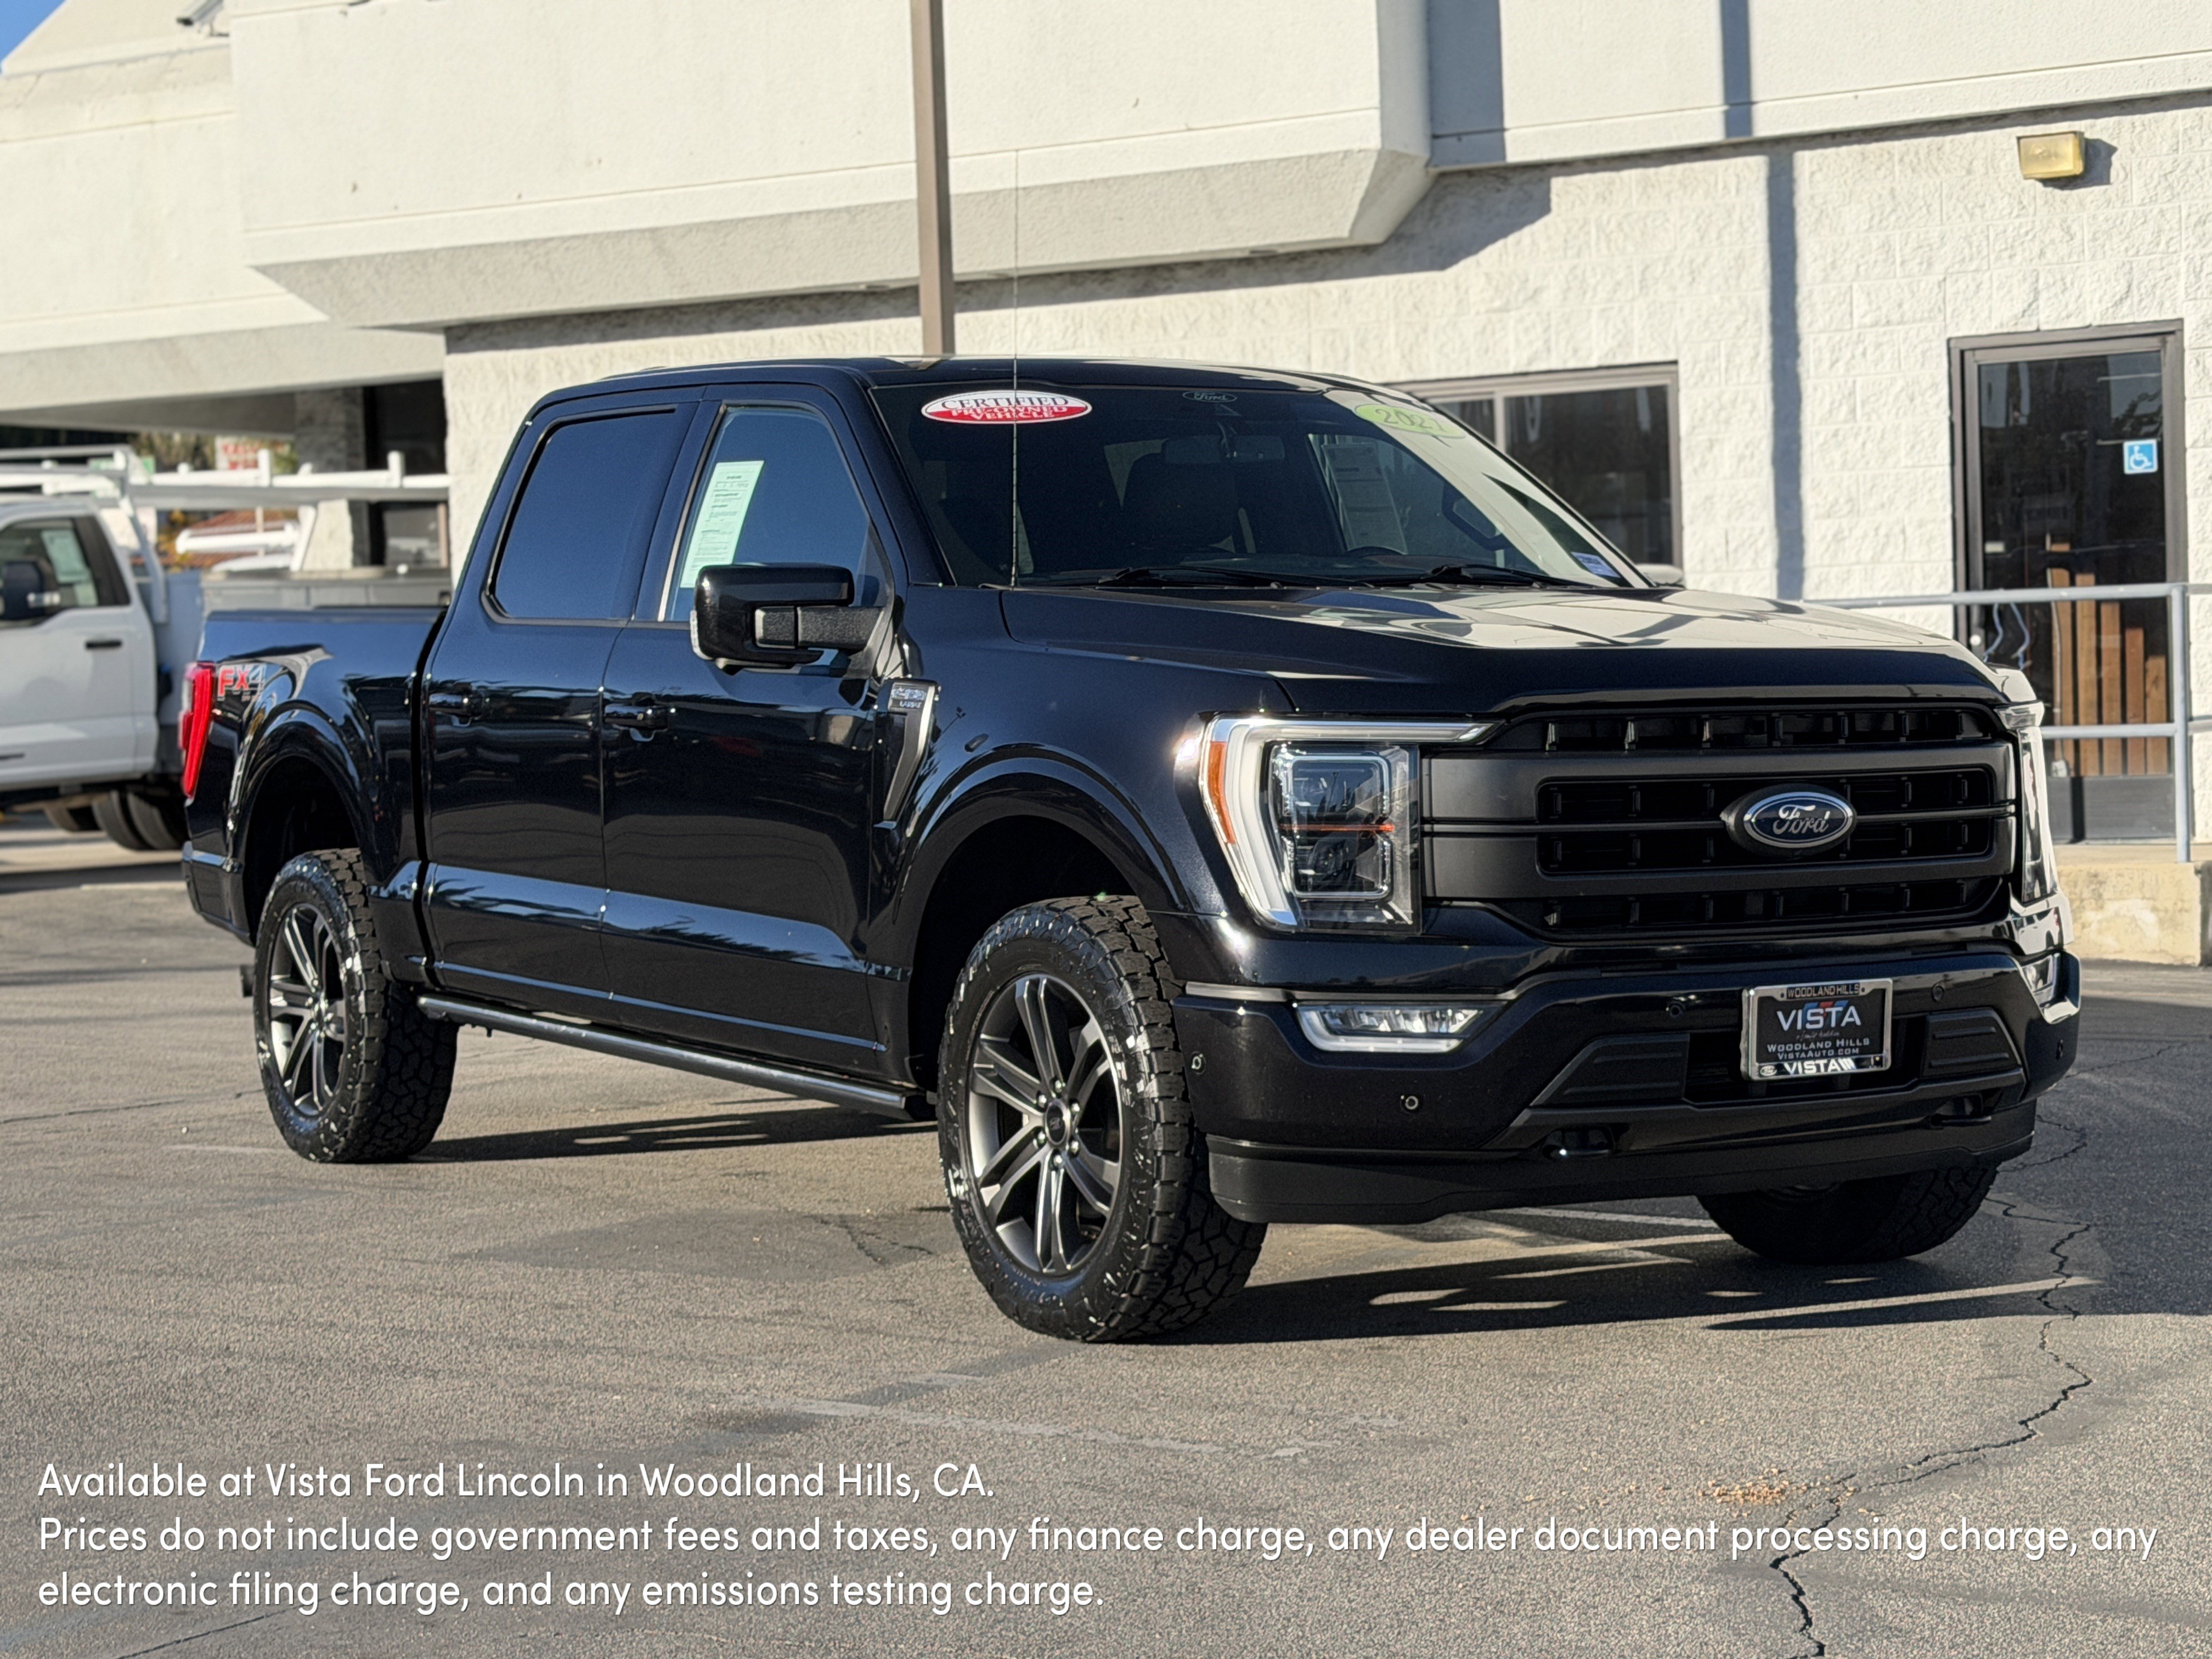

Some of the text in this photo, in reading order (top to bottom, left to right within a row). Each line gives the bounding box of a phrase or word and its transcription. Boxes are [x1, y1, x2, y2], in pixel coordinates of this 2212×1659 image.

[941, 397, 1069, 410] CERTIFIED
[1193, 391, 1229, 401] Ford
[970, 409, 1055, 420] VEHICLE
[217, 663, 268, 698] FX4
[1773, 804, 1831, 834] Ford
[1787, 983, 1860, 997] WOODLAND HILLS
[1776, 1005, 1862, 1031] VISTA
[1767, 1037, 1870, 1053] WOODLAND HILLS
[1784, 1058, 1841, 1075] VISTA
